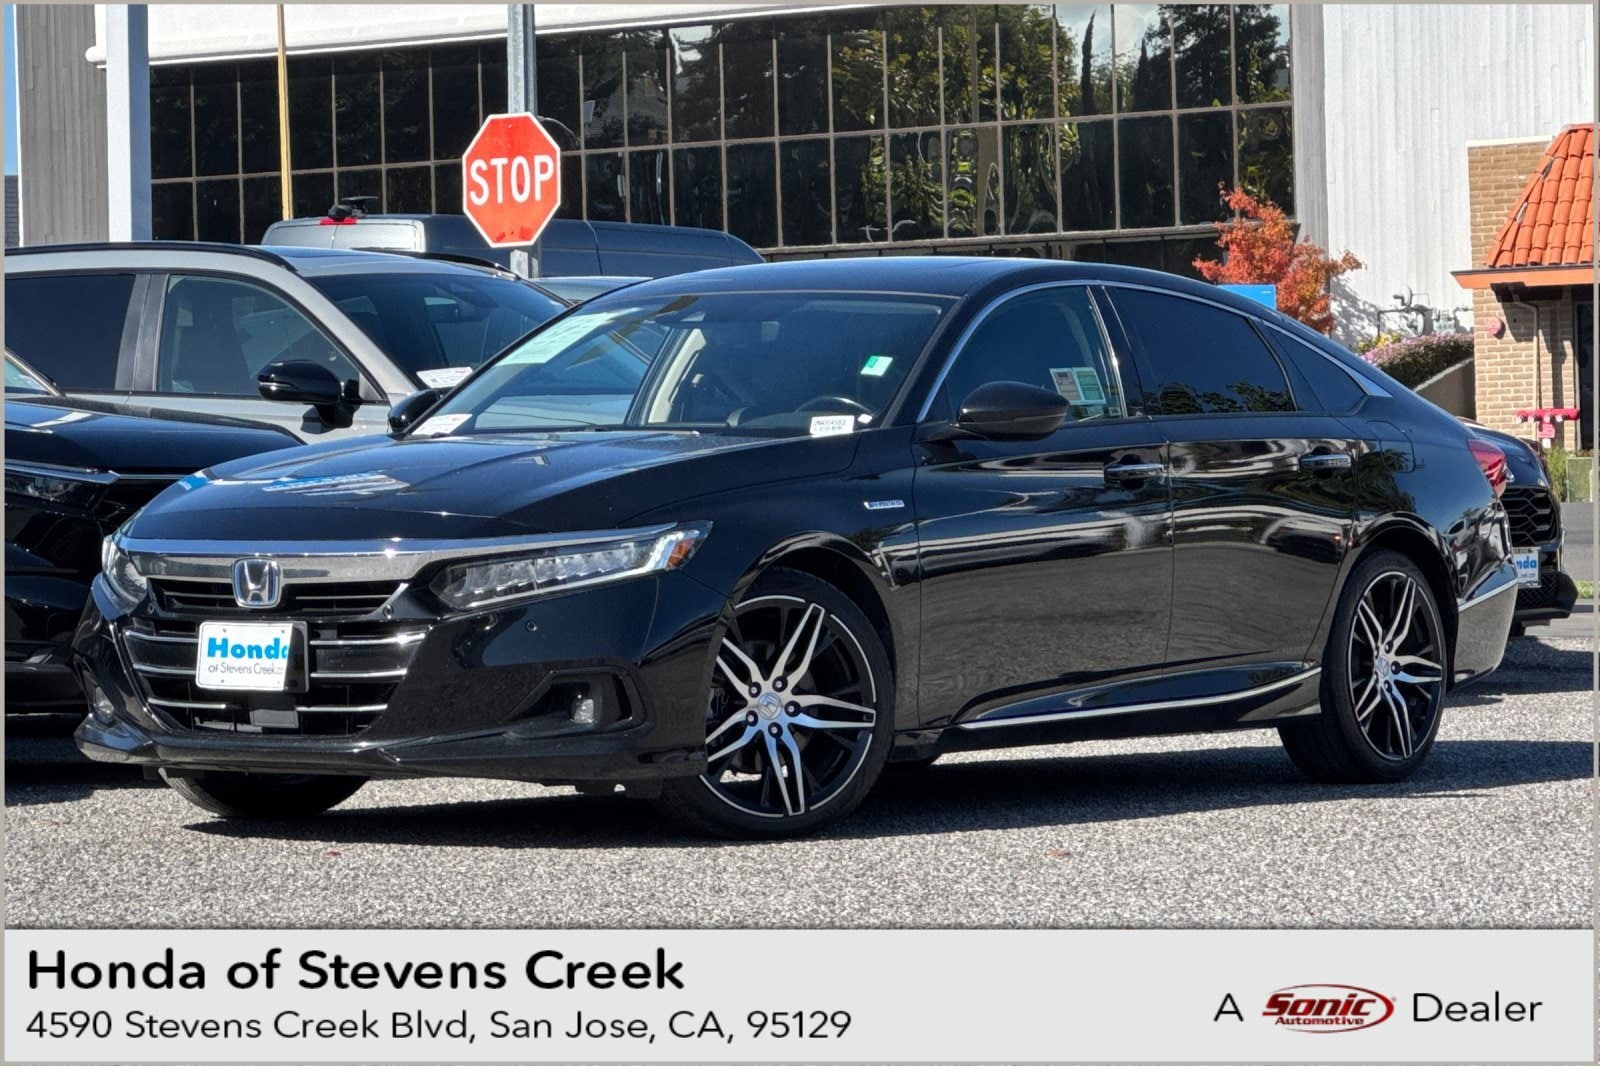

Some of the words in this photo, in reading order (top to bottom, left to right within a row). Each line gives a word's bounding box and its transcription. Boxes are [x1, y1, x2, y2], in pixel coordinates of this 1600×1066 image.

[469, 154, 554, 206] STOP
[1515, 555, 1537, 570] nda
[207, 663, 219, 674] of
[220, 661, 253, 675] Stevens
